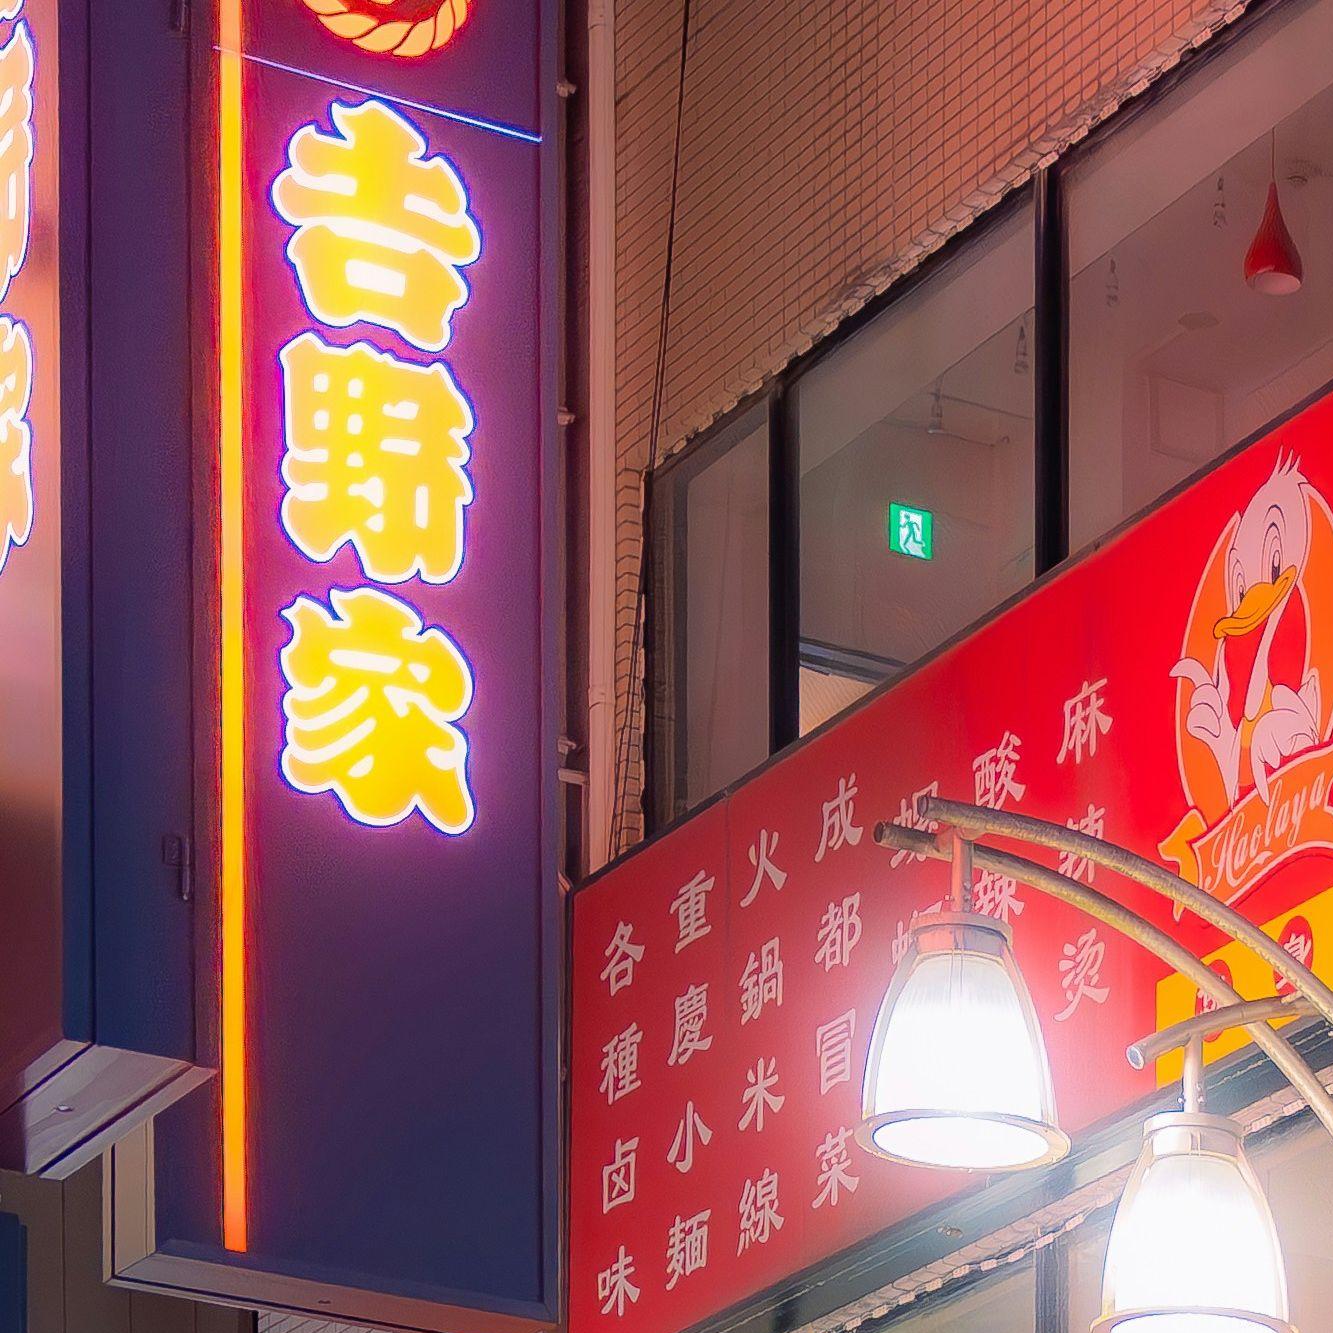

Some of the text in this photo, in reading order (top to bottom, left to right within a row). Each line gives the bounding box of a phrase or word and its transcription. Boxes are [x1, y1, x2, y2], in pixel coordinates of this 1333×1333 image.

[811, 772, 863, 1210] 成都冒菜
[1203, 771, 1326, 892] Haolaya
[597, 920, 646, 1317] 各種卤味
[737, 827, 788, 1258] 火鍋米線
